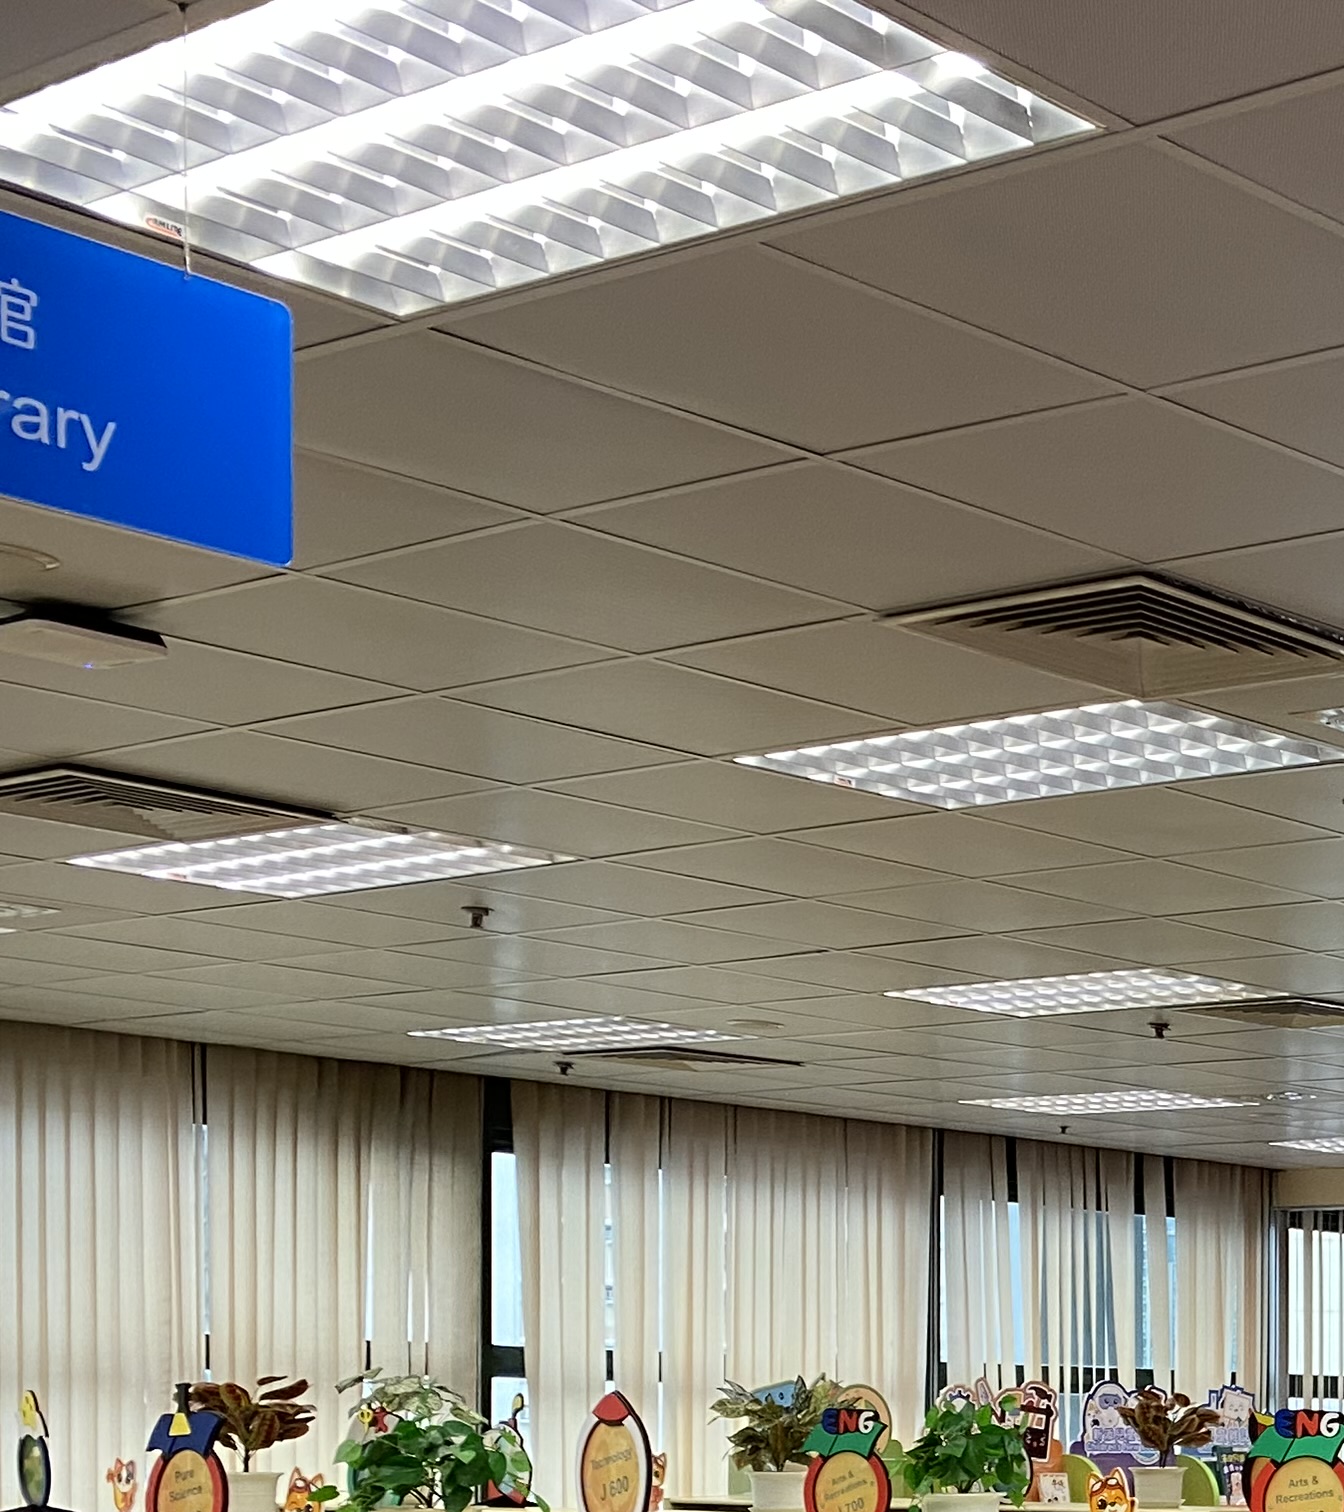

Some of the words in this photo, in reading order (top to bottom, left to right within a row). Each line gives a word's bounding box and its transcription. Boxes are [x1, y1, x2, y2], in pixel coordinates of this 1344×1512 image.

[0, 390, 117, 471] ary
[822, 1408, 876, 1435] ENG
[1274, 1409, 1340, 1438] ENG
[600, 1483, 606, 1502] J
[609, 1476, 629, 1498] 600
[1288, 1478, 1308, 1489] Arts
[1311, 1475, 1319, 1485] &
[1275, 1489, 1334, 1505] Recreations
